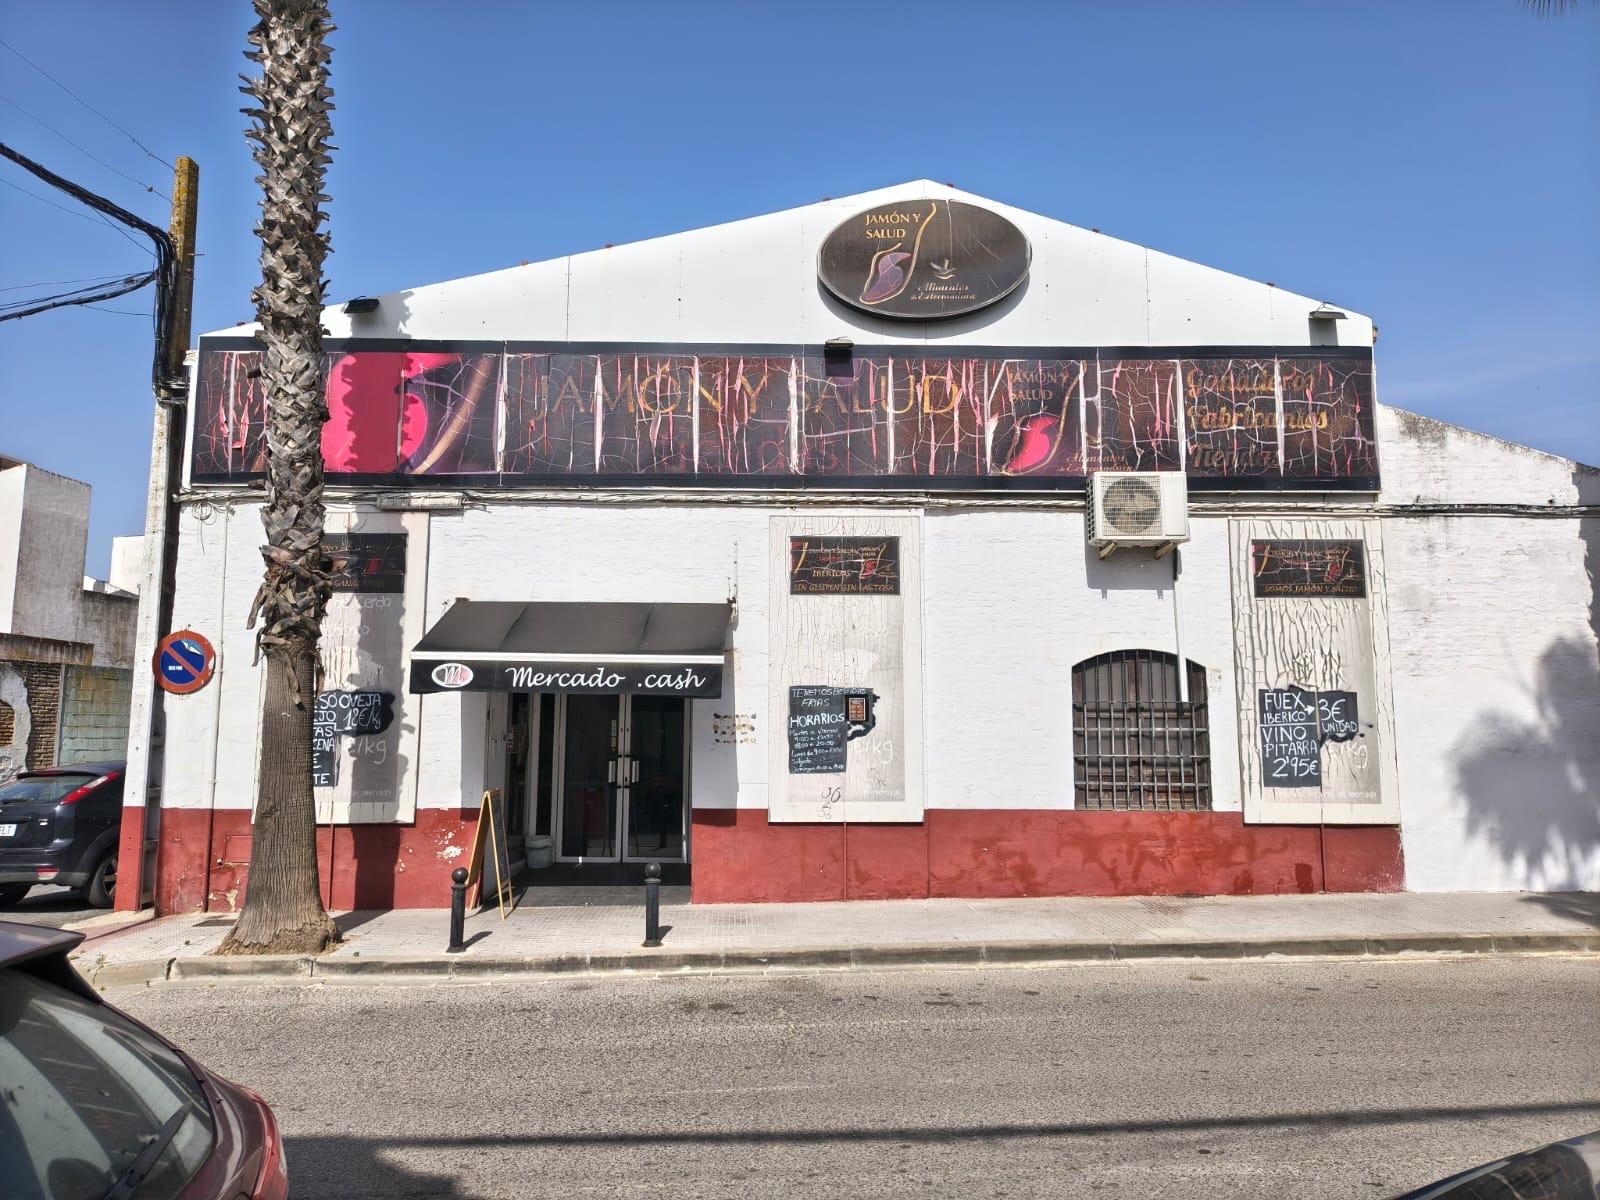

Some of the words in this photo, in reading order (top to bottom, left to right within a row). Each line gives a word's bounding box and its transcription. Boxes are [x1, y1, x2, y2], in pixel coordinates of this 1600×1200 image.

[865, 211, 910, 226] JAMÓN
[912, 212, 921, 223] Y
[866, 228, 906, 239] SALUD
[737, 374, 768, 414] Y
[505, 666, 626, 689] Mercado
[339, 692, 381, 709] OVEJA
[1264, 692, 1304, 710] FUEX
[1319, 698, 1346, 723] 3€
[790, 712, 845, 728] HORARIOS
[1263, 711, 1307, 725] IBERICO
[1321, 720, 1359, 733] UNIDAD
[1262, 726, 1307, 744] VINO
[1264, 740, 1318, 758] PITARRA
